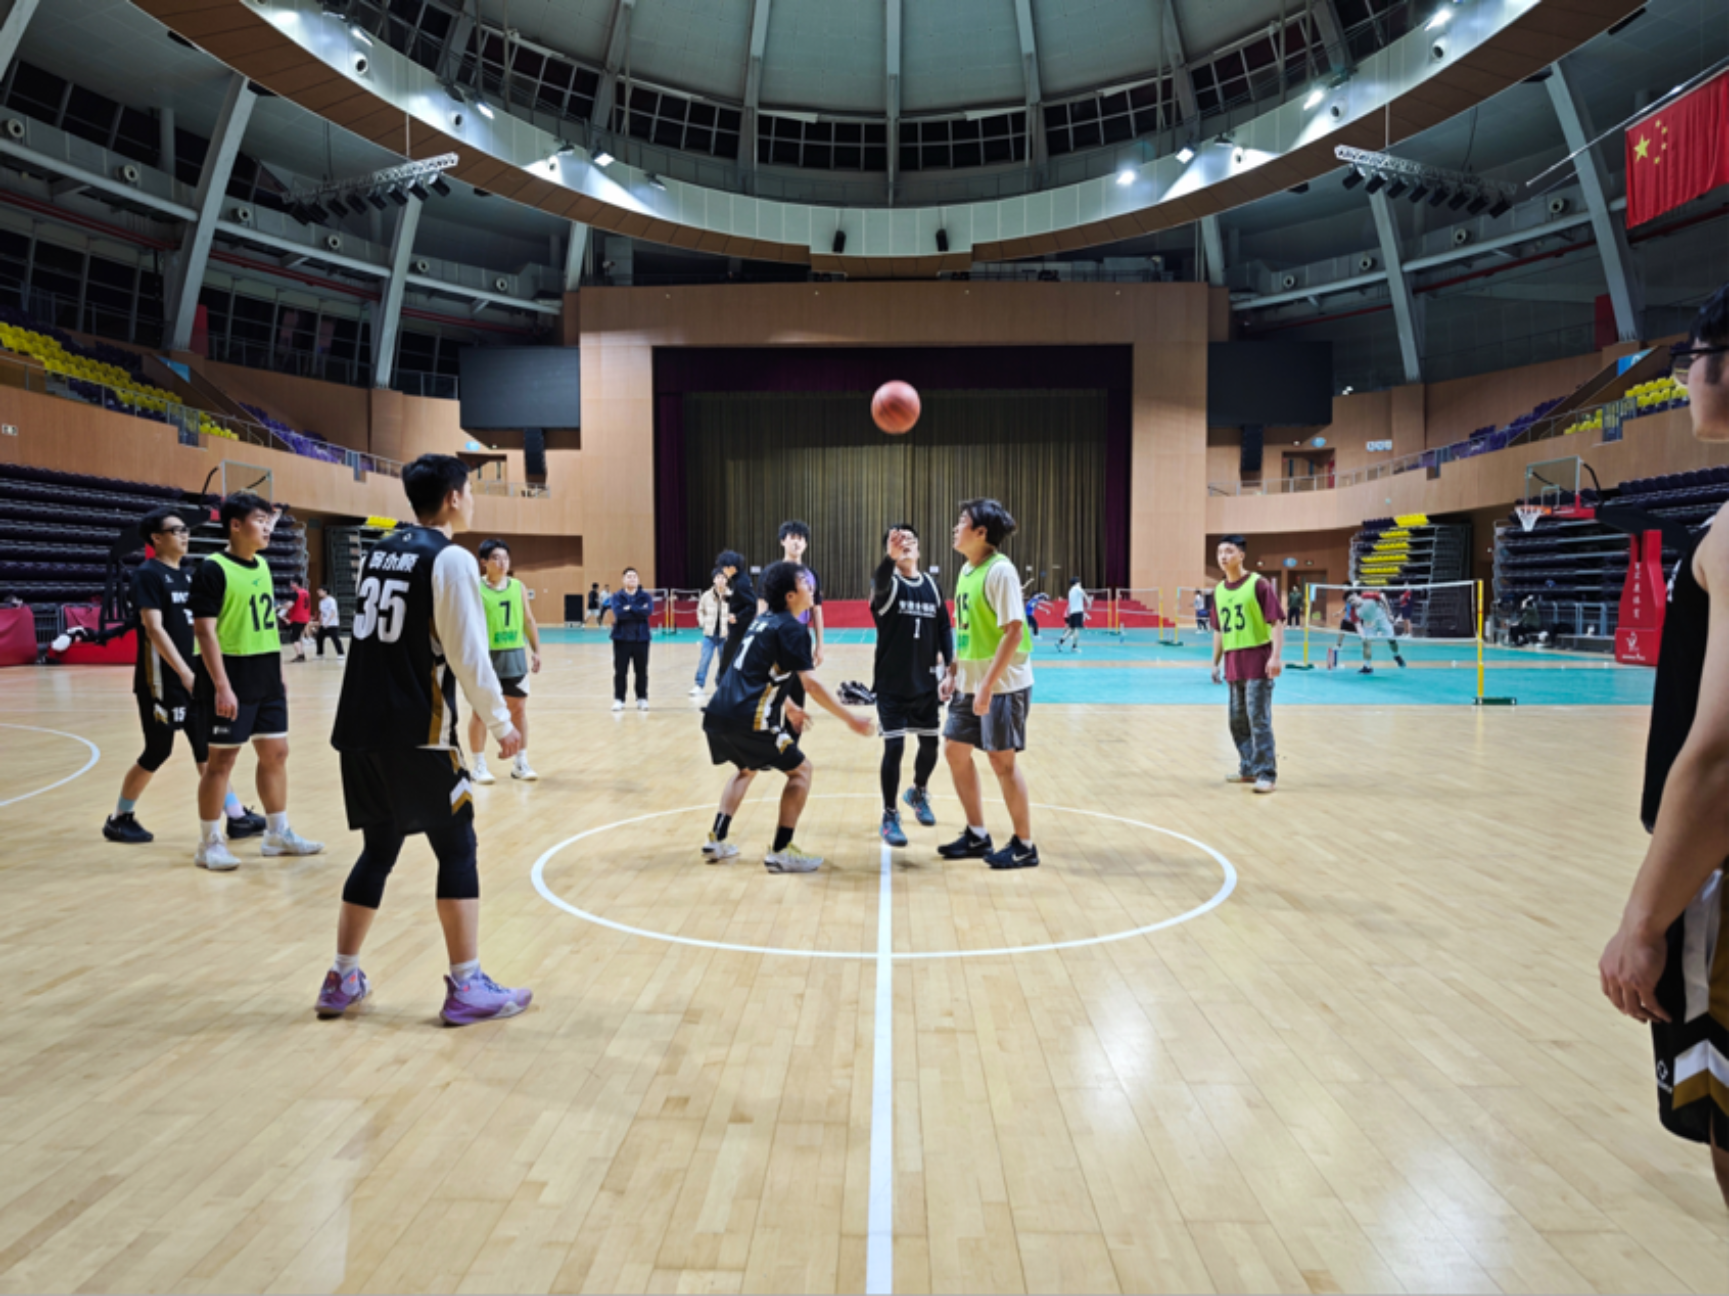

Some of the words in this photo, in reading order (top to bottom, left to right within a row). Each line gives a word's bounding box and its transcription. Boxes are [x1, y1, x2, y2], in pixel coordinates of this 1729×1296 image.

[249, 592, 274, 632] 12
[353, 576, 410, 643] 35
[500, 600, 511, 627] 7
[1220, 604, 1245, 633] 23
[172, 706, 186, 721] 15
